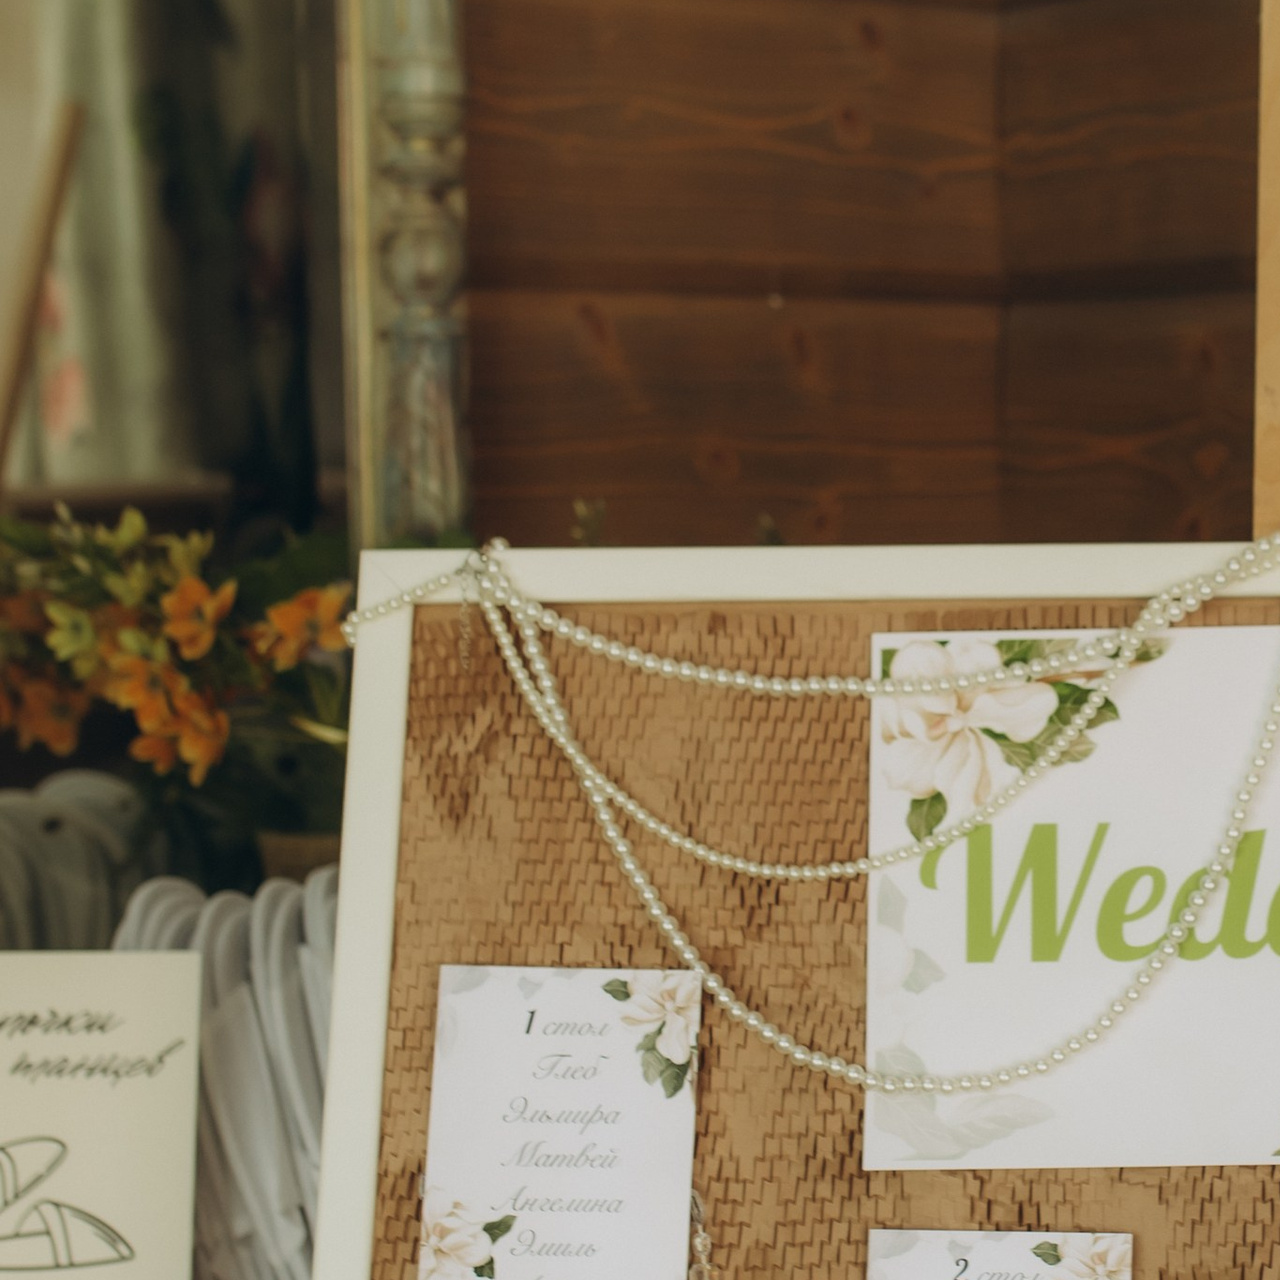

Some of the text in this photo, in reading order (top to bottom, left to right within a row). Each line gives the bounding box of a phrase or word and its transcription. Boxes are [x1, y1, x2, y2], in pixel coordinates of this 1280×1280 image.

[524, 1008, 609, 1036] 1 стол
[502, 1096, 621, 1133] Эльмира
[500, 1141, 618, 1168] Матвей
[490, 1186, 624, 1213] Ангелина
[510, 1229, 597, 1257] Эмиль
